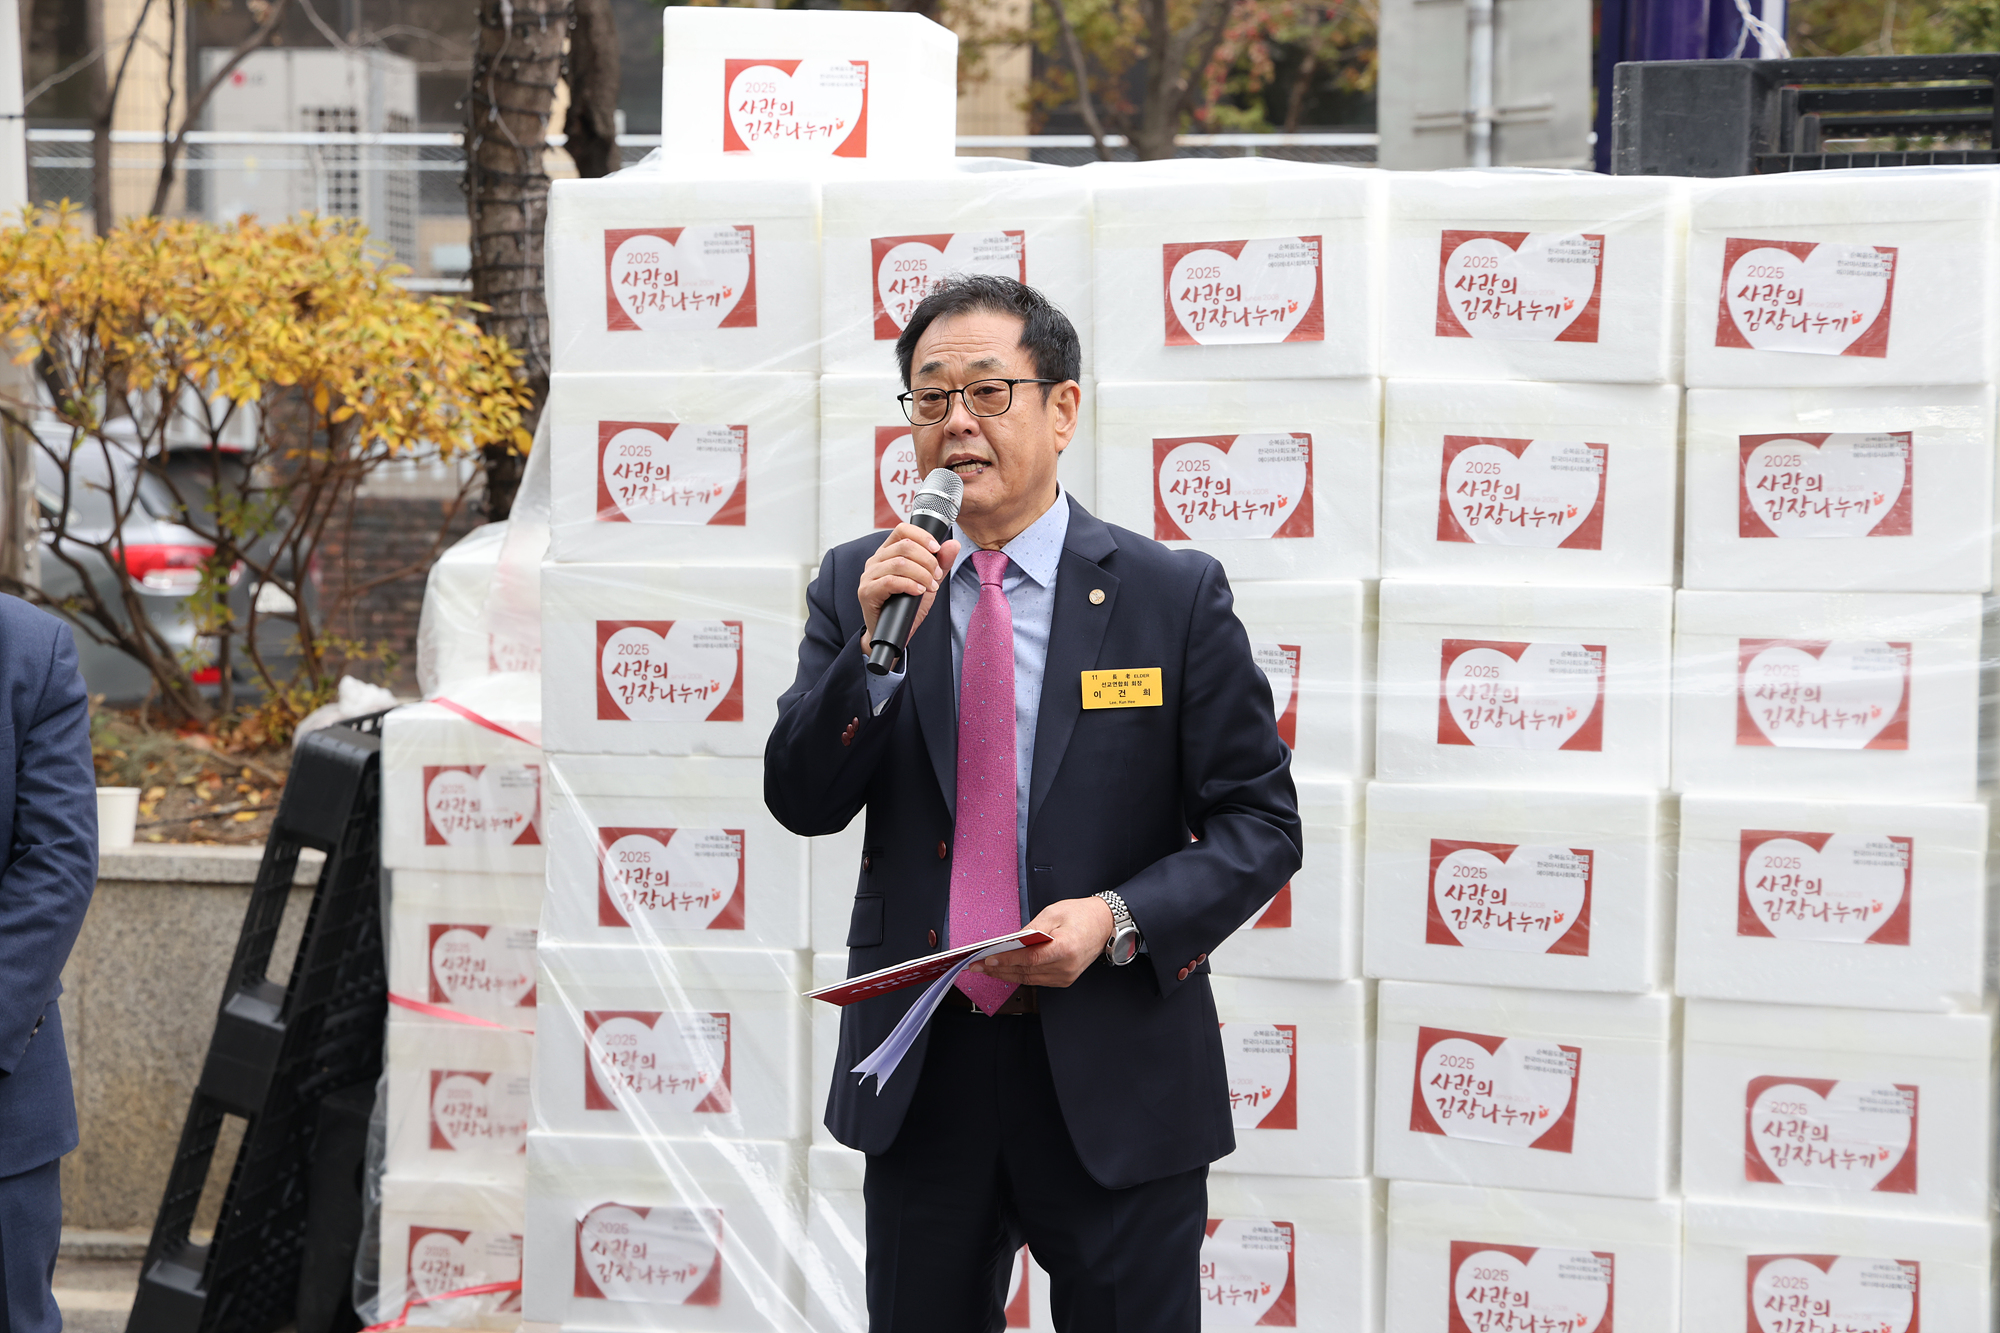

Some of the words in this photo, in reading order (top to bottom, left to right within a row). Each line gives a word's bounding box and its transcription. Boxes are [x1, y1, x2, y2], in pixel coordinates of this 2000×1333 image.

[744, 81, 776, 93] 2025
[738, 97, 793, 117] 사랑의
[744, 118, 833, 140] 김장나누기
[626, 251, 659, 263] 2025
[894, 258, 927, 271] 2025
[1463, 255, 1498, 268] 2025
[620, 267, 678, 289] 사랑의
[1186, 266, 1220, 279] 2025
[1747, 264, 1784, 278] 2025
[1180, 282, 1240, 304] 사랑의
[1454, 273, 1517, 295] 사랑의
[1737, 283, 1803, 306] 사랑의
[628, 289, 720, 314] 김장나누기
[1461, 296, 1560, 320] 김장나누기
[1188, 304, 1285, 331] 김장나누기
[1743, 307, 1848, 333] 김장나누기
[619, 444, 651, 456] 2025
[897, 451, 917, 463] 20
[612, 461, 669, 482] 사랑의
[1176, 459, 1210, 472] 2025
[1465, 461, 1500, 474] 2025
[1764, 455, 1801, 468] 2025
[1169, 476, 1230, 497] 사랑의
[1456, 479, 1520, 501] 사랑의
[1756, 472, 1822, 494] 사랑의
[619, 483, 710, 506] 김장나누기
[1177, 498, 1274, 523] 김장나누기
[1463, 502, 1563, 527] 김장나누기
[1764, 494, 1870, 520] 김장나누기
[617, 643, 649, 655] 2025
[611, 659, 667, 680] 사랑의
[1464, 665, 1499, 678] 2025
[1762, 664, 1799, 676] 2025
[618, 681, 708, 704] 김장나누기
[1143, 688, 1151, 696] 희
[1455, 683, 1518, 705] 사랑의
[1754, 681, 1820, 704] 사랑의
[1462, 705, 1563, 730] 김장나누기
[1762, 705, 1867, 729] 김장나누기
[435, 796, 480, 814] 사랑의
[619, 850, 651, 862] 2025
[1764, 855, 1801, 869] 2025
[612, 867, 668, 888] 사랑의
[1452, 865, 1487, 879] 2025
[1444, 883, 1506, 905] 사랑의
[1755, 873, 1821, 896] 사랑의
[1451, 906, 1550, 932] 김장나누기
[1763, 897, 1868, 922] 김장나누기
[605, 1033, 637, 1045] 2025
[1439, 1054, 1474, 1069] 2025
[1430, 1073, 1492, 1097] 사랑의
[1436, 1096, 1535, 1125] 김장나누기
[1770, 1101, 1807, 1115] 2025
[1762, 1119, 1828, 1142] 사랑의
[1770, 1143, 1875, 1169] 김장나누기
[598, 1223, 629, 1235] 2025
[590, 1239, 646, 1260] 사랑의
[1473, 1267, 1508, 1281] 2025
[1771, 1275, 1808, 1289] 2025
[1201, 1285, 1258, 1305] 나누기
[1465, 1285, 1528, 1308] 사랑의
[1763, 1294, 1829, 1317] 사랑의
[1473, 1309, 1573, 1333] 김장나누기
